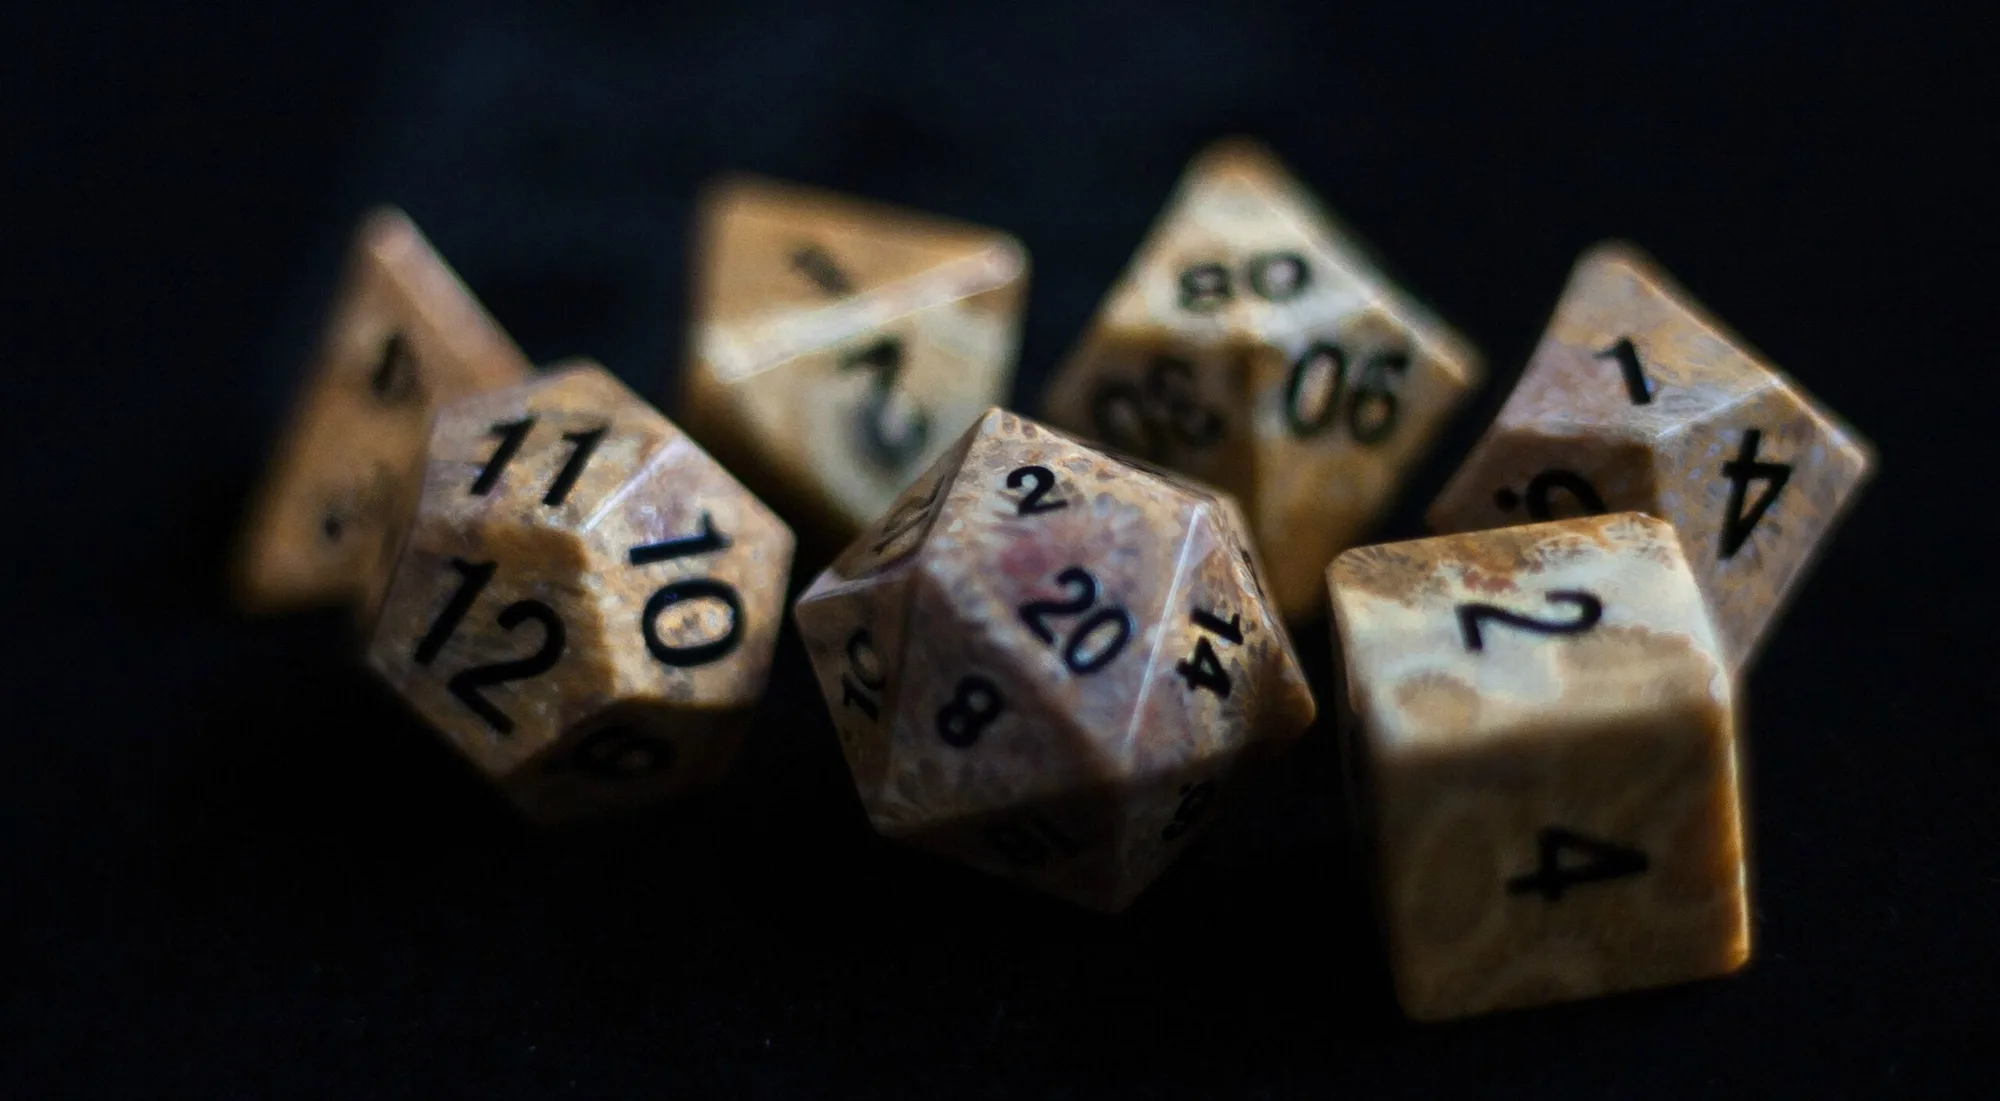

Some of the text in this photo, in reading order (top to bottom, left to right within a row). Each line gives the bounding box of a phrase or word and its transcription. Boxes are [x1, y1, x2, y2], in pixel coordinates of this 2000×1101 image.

[1178, 253, 1312, 312] 80
[1594, 336, 1653, 404] 1
[469, 415, 608, 506] 11
[1007, 465, 1068, 514] 2
[1720, 430, 1793, 557] 4
[629, 511, 743, 667] 10
[1018, 567, 1131, 674] 20
[1456, 590, 1602, 651] 2
[414, 557, 567, 736] 12
[842, 626, 890, 724] 10
[1176, 607, 1243, 698] 14
[937, 675, 1005, 748] 8
[1506, 826, 1650, 902] 4
